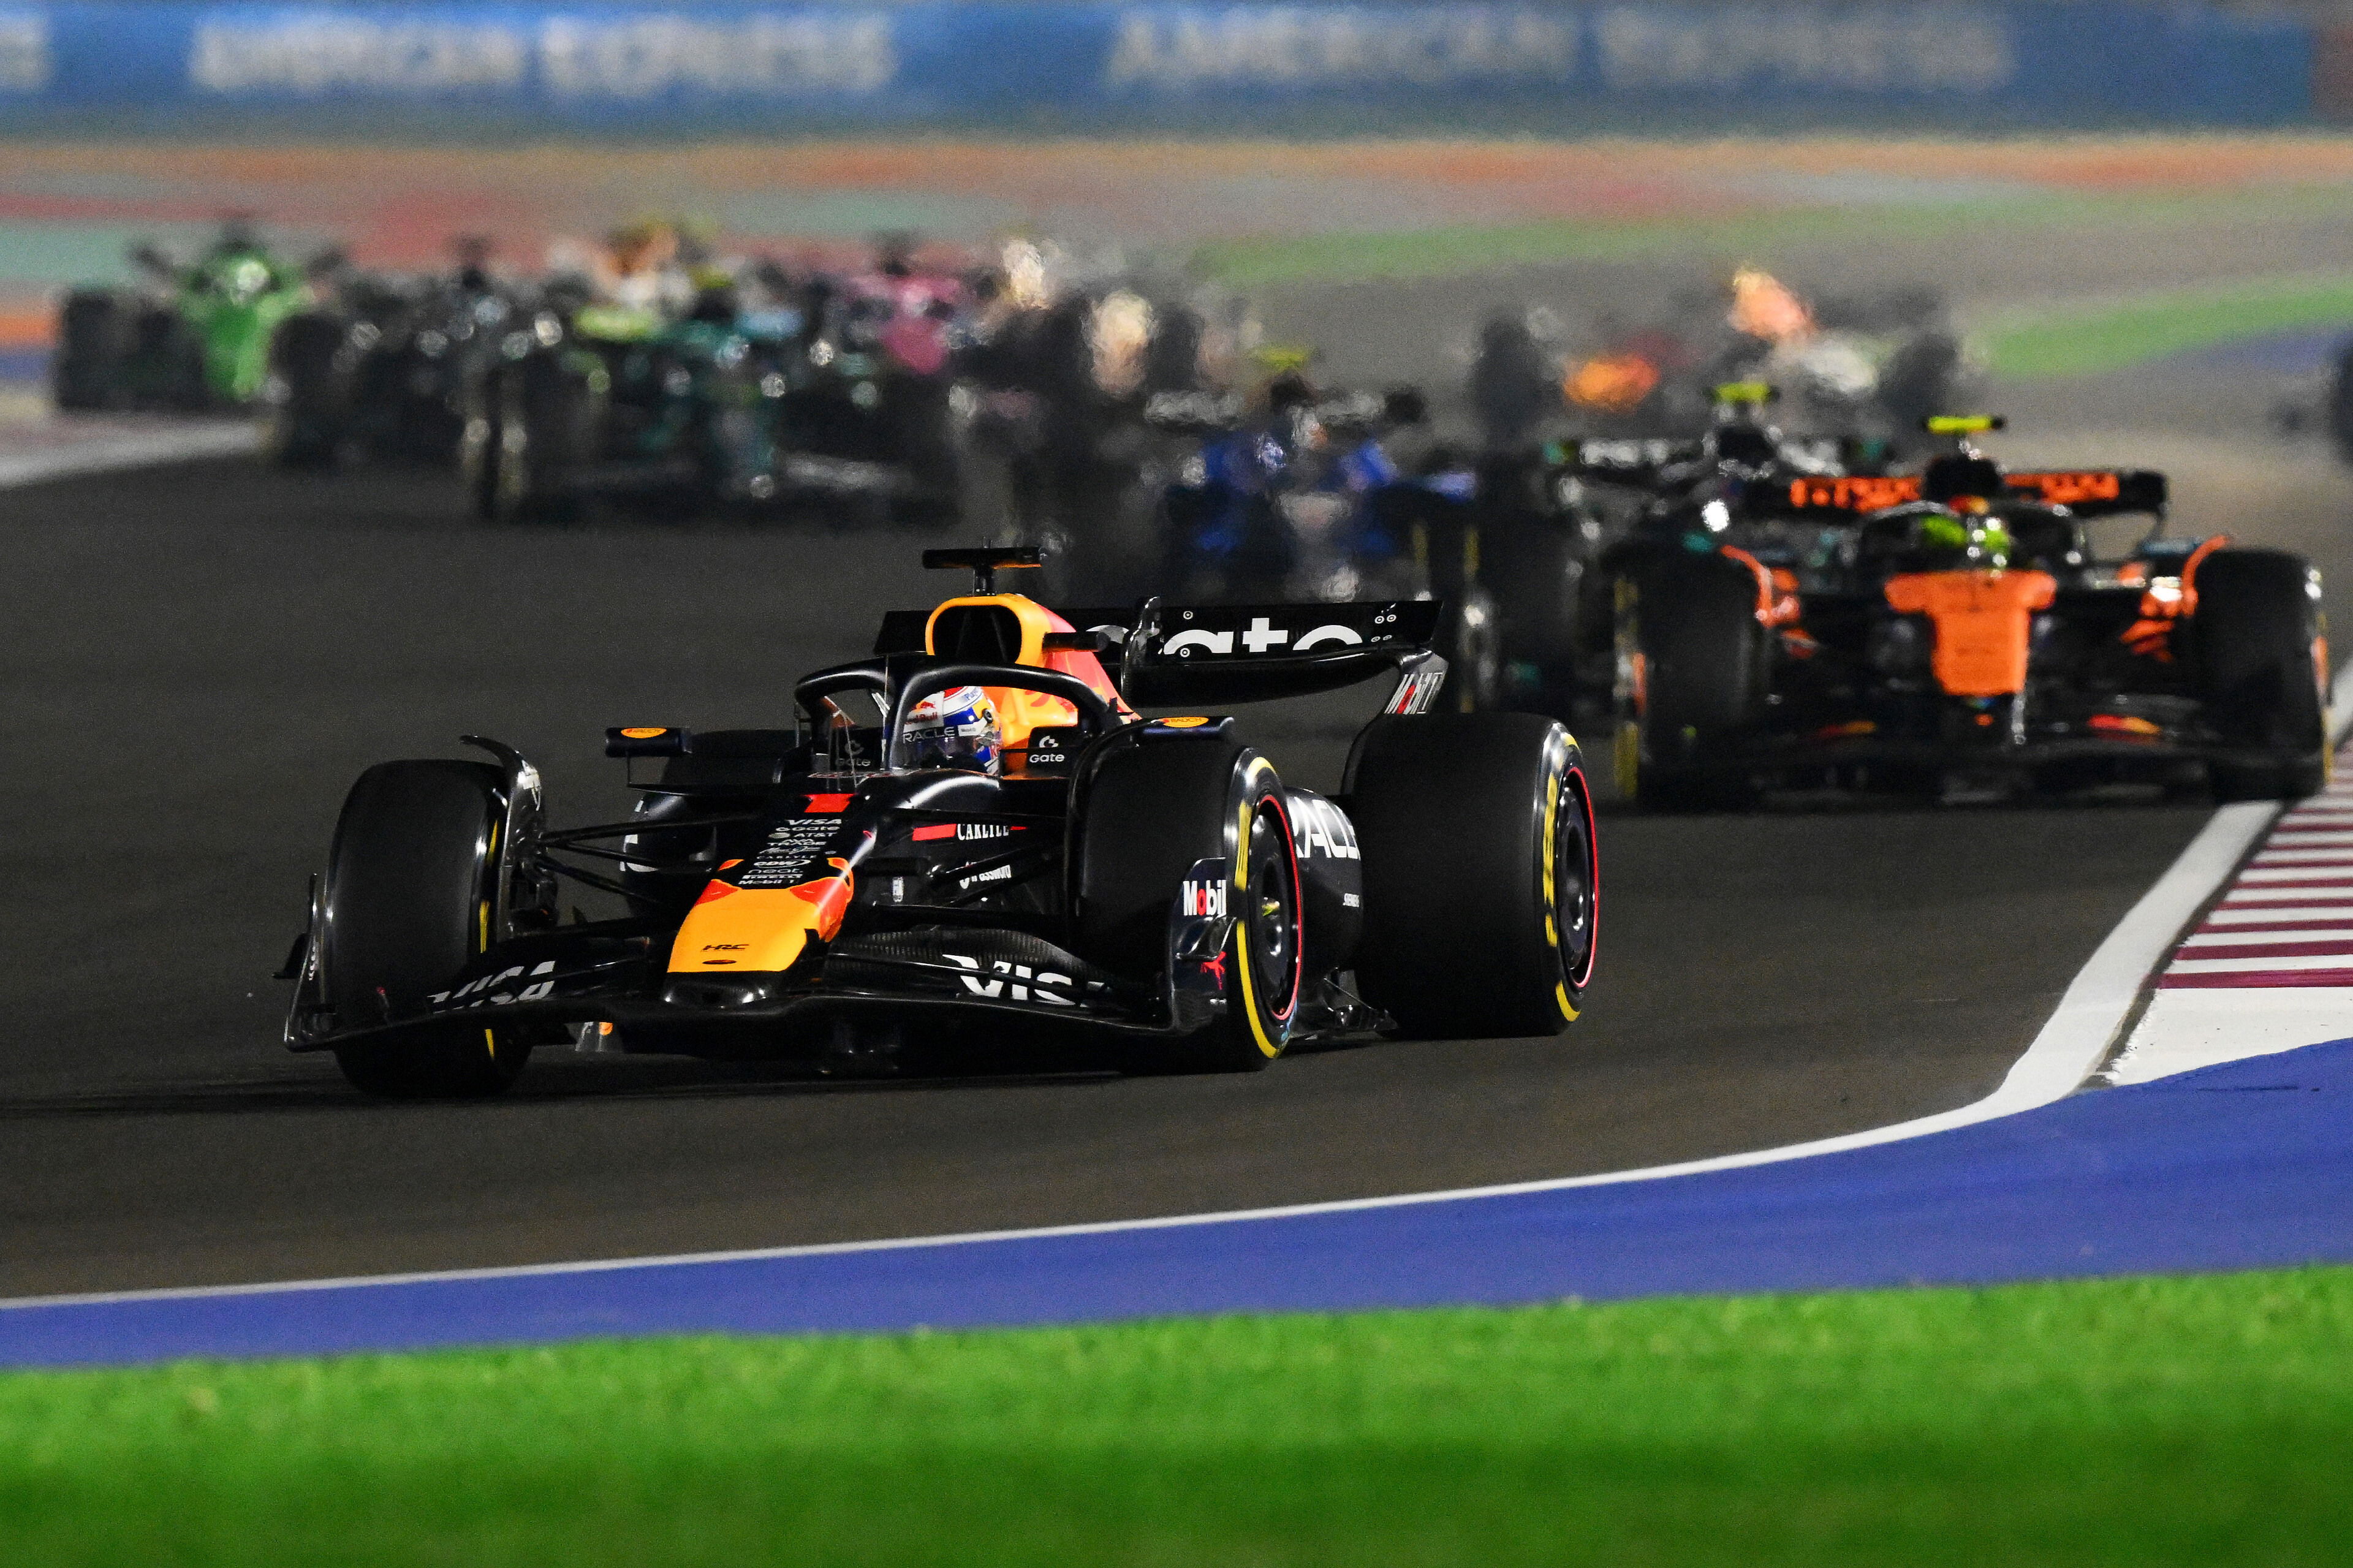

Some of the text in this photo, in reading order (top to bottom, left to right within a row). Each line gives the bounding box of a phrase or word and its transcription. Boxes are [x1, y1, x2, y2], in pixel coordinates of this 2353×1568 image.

[903, 727, 955, 744] RACLE
[1029, 752, 1065, 763] Gate
[1183, 880, 1227, 916] Mobil
[942, 953, 1109, 1008] VIS
